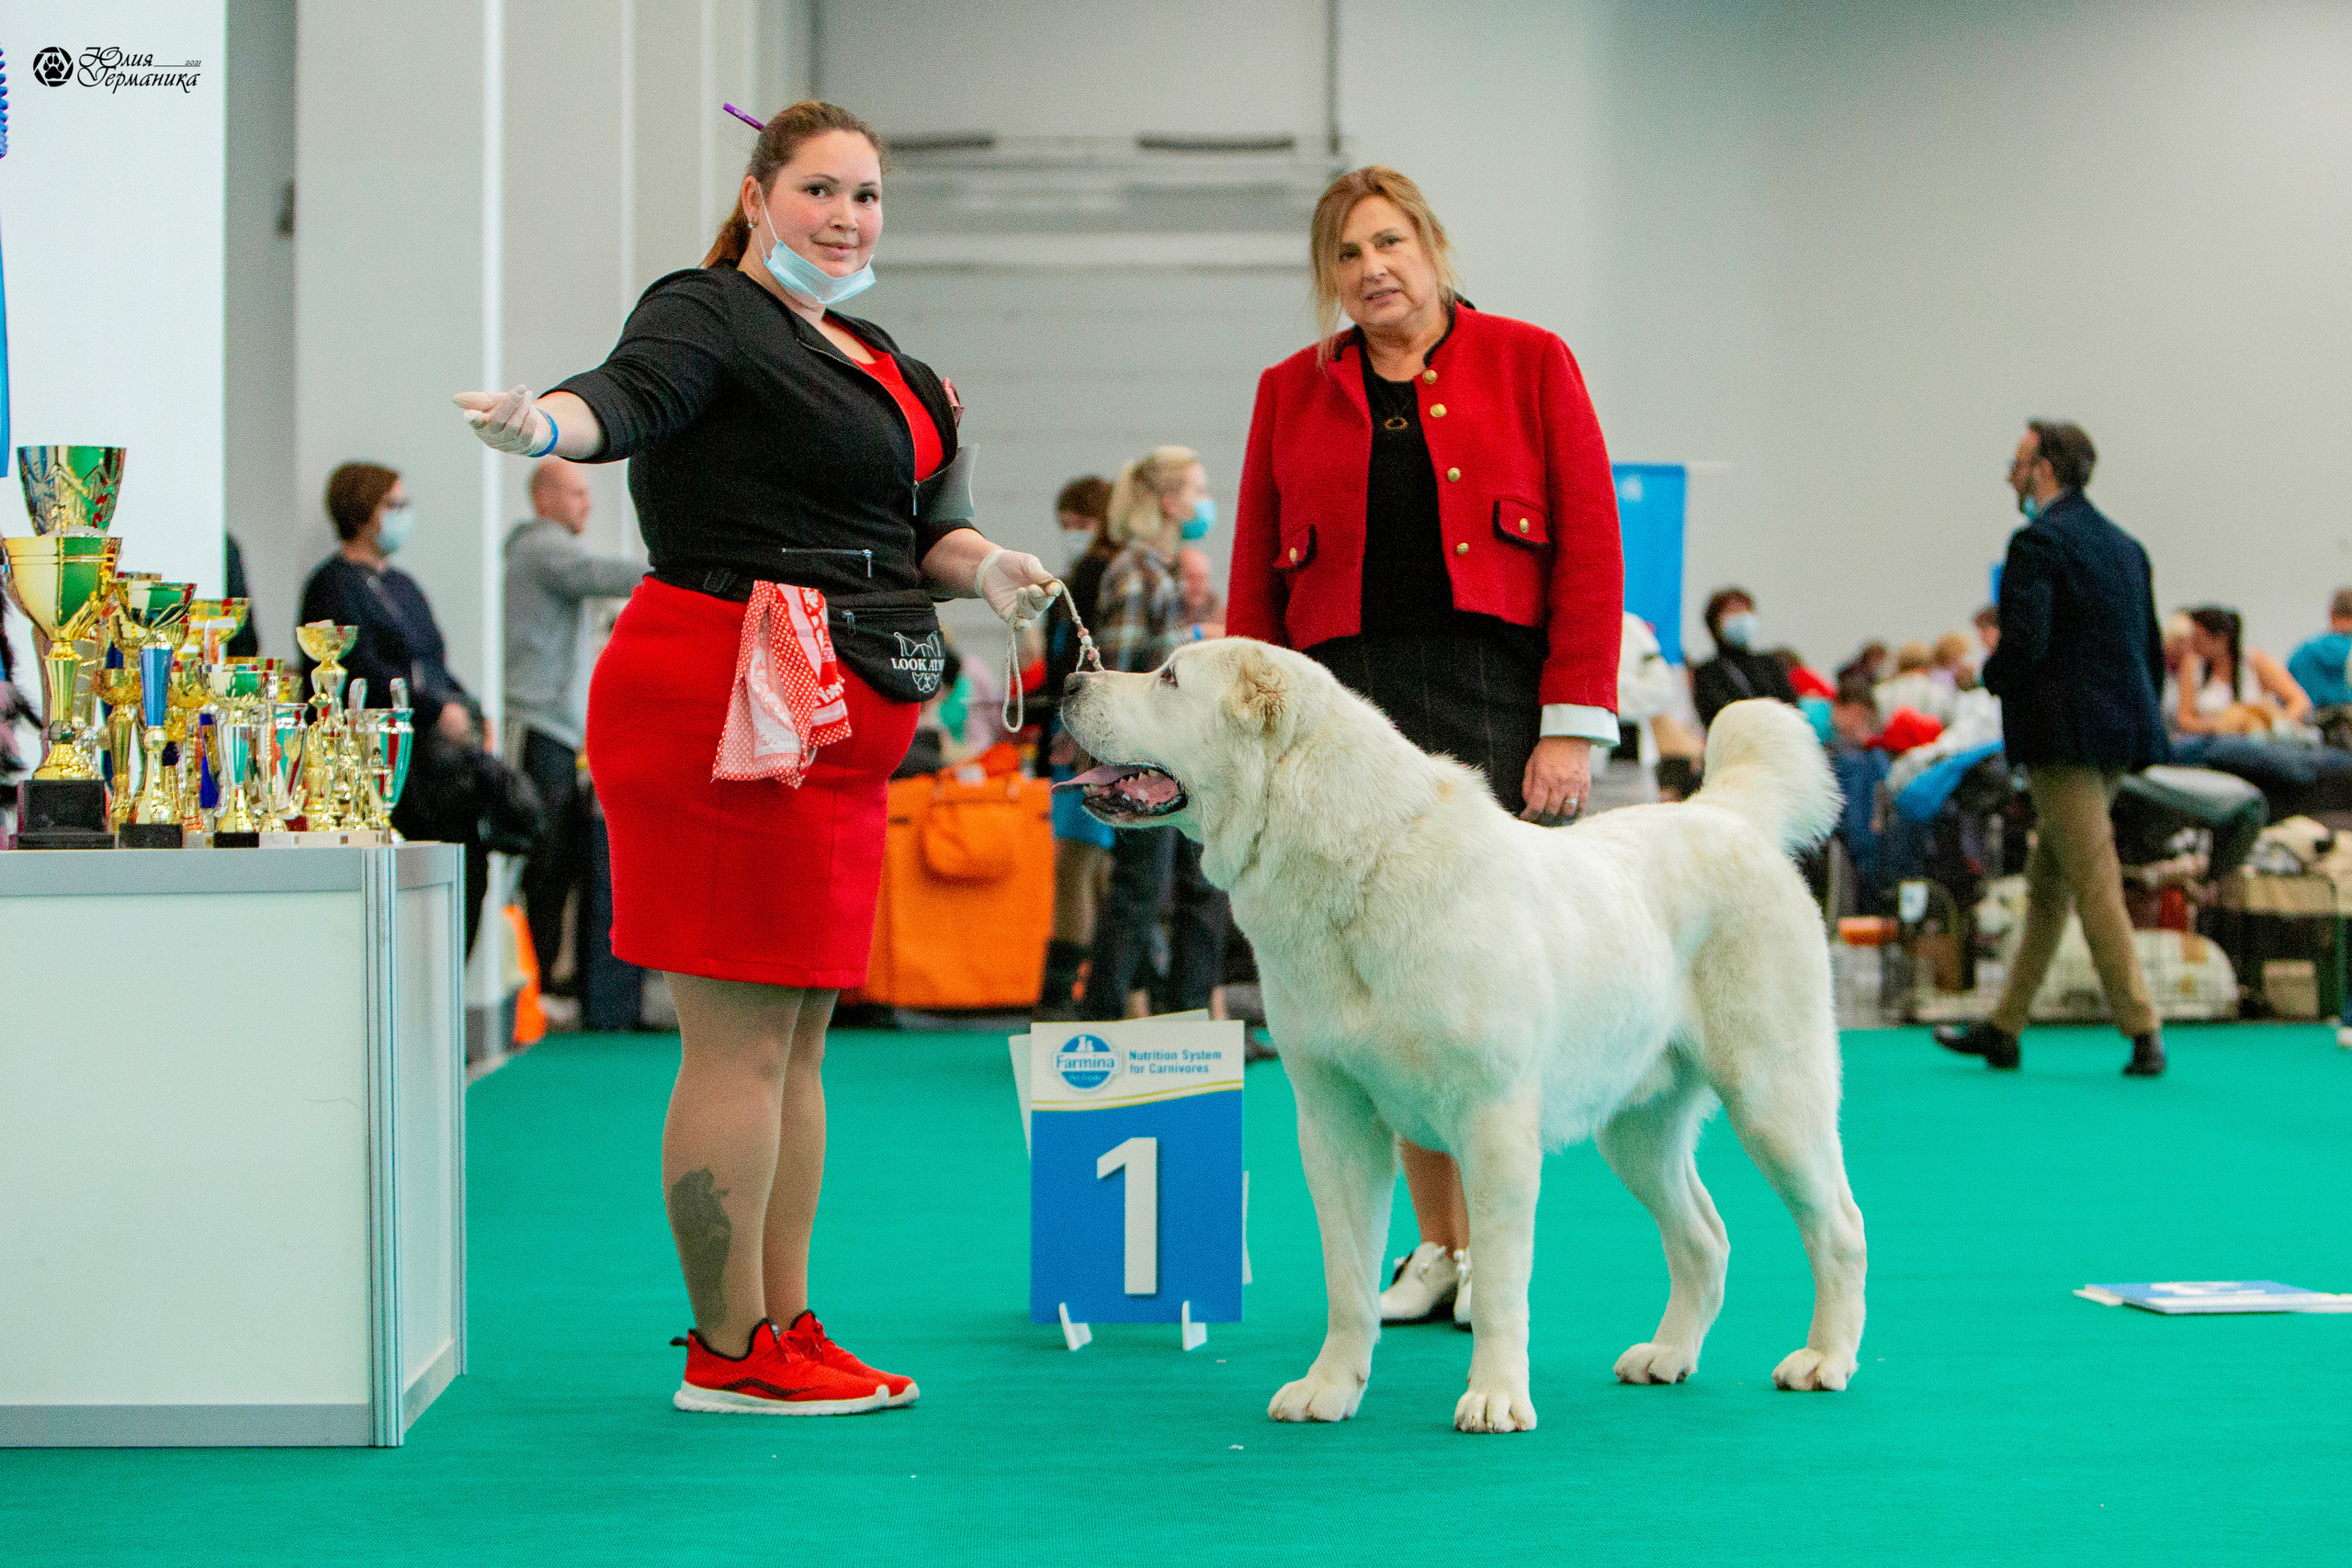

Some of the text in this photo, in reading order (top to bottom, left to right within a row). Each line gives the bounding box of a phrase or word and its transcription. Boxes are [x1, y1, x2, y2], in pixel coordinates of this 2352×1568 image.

[890, 658, 927, 671] LOOK
[928, 659, 937, 671] AT
[1057, 1054, 1114, 1068] Farmina
[1129, 1049, 1222, 1062] Nutrition System
[1129, 1063, 1209, 1074] for Carnivores
[1097, 1136, 1157, 1294] 1
